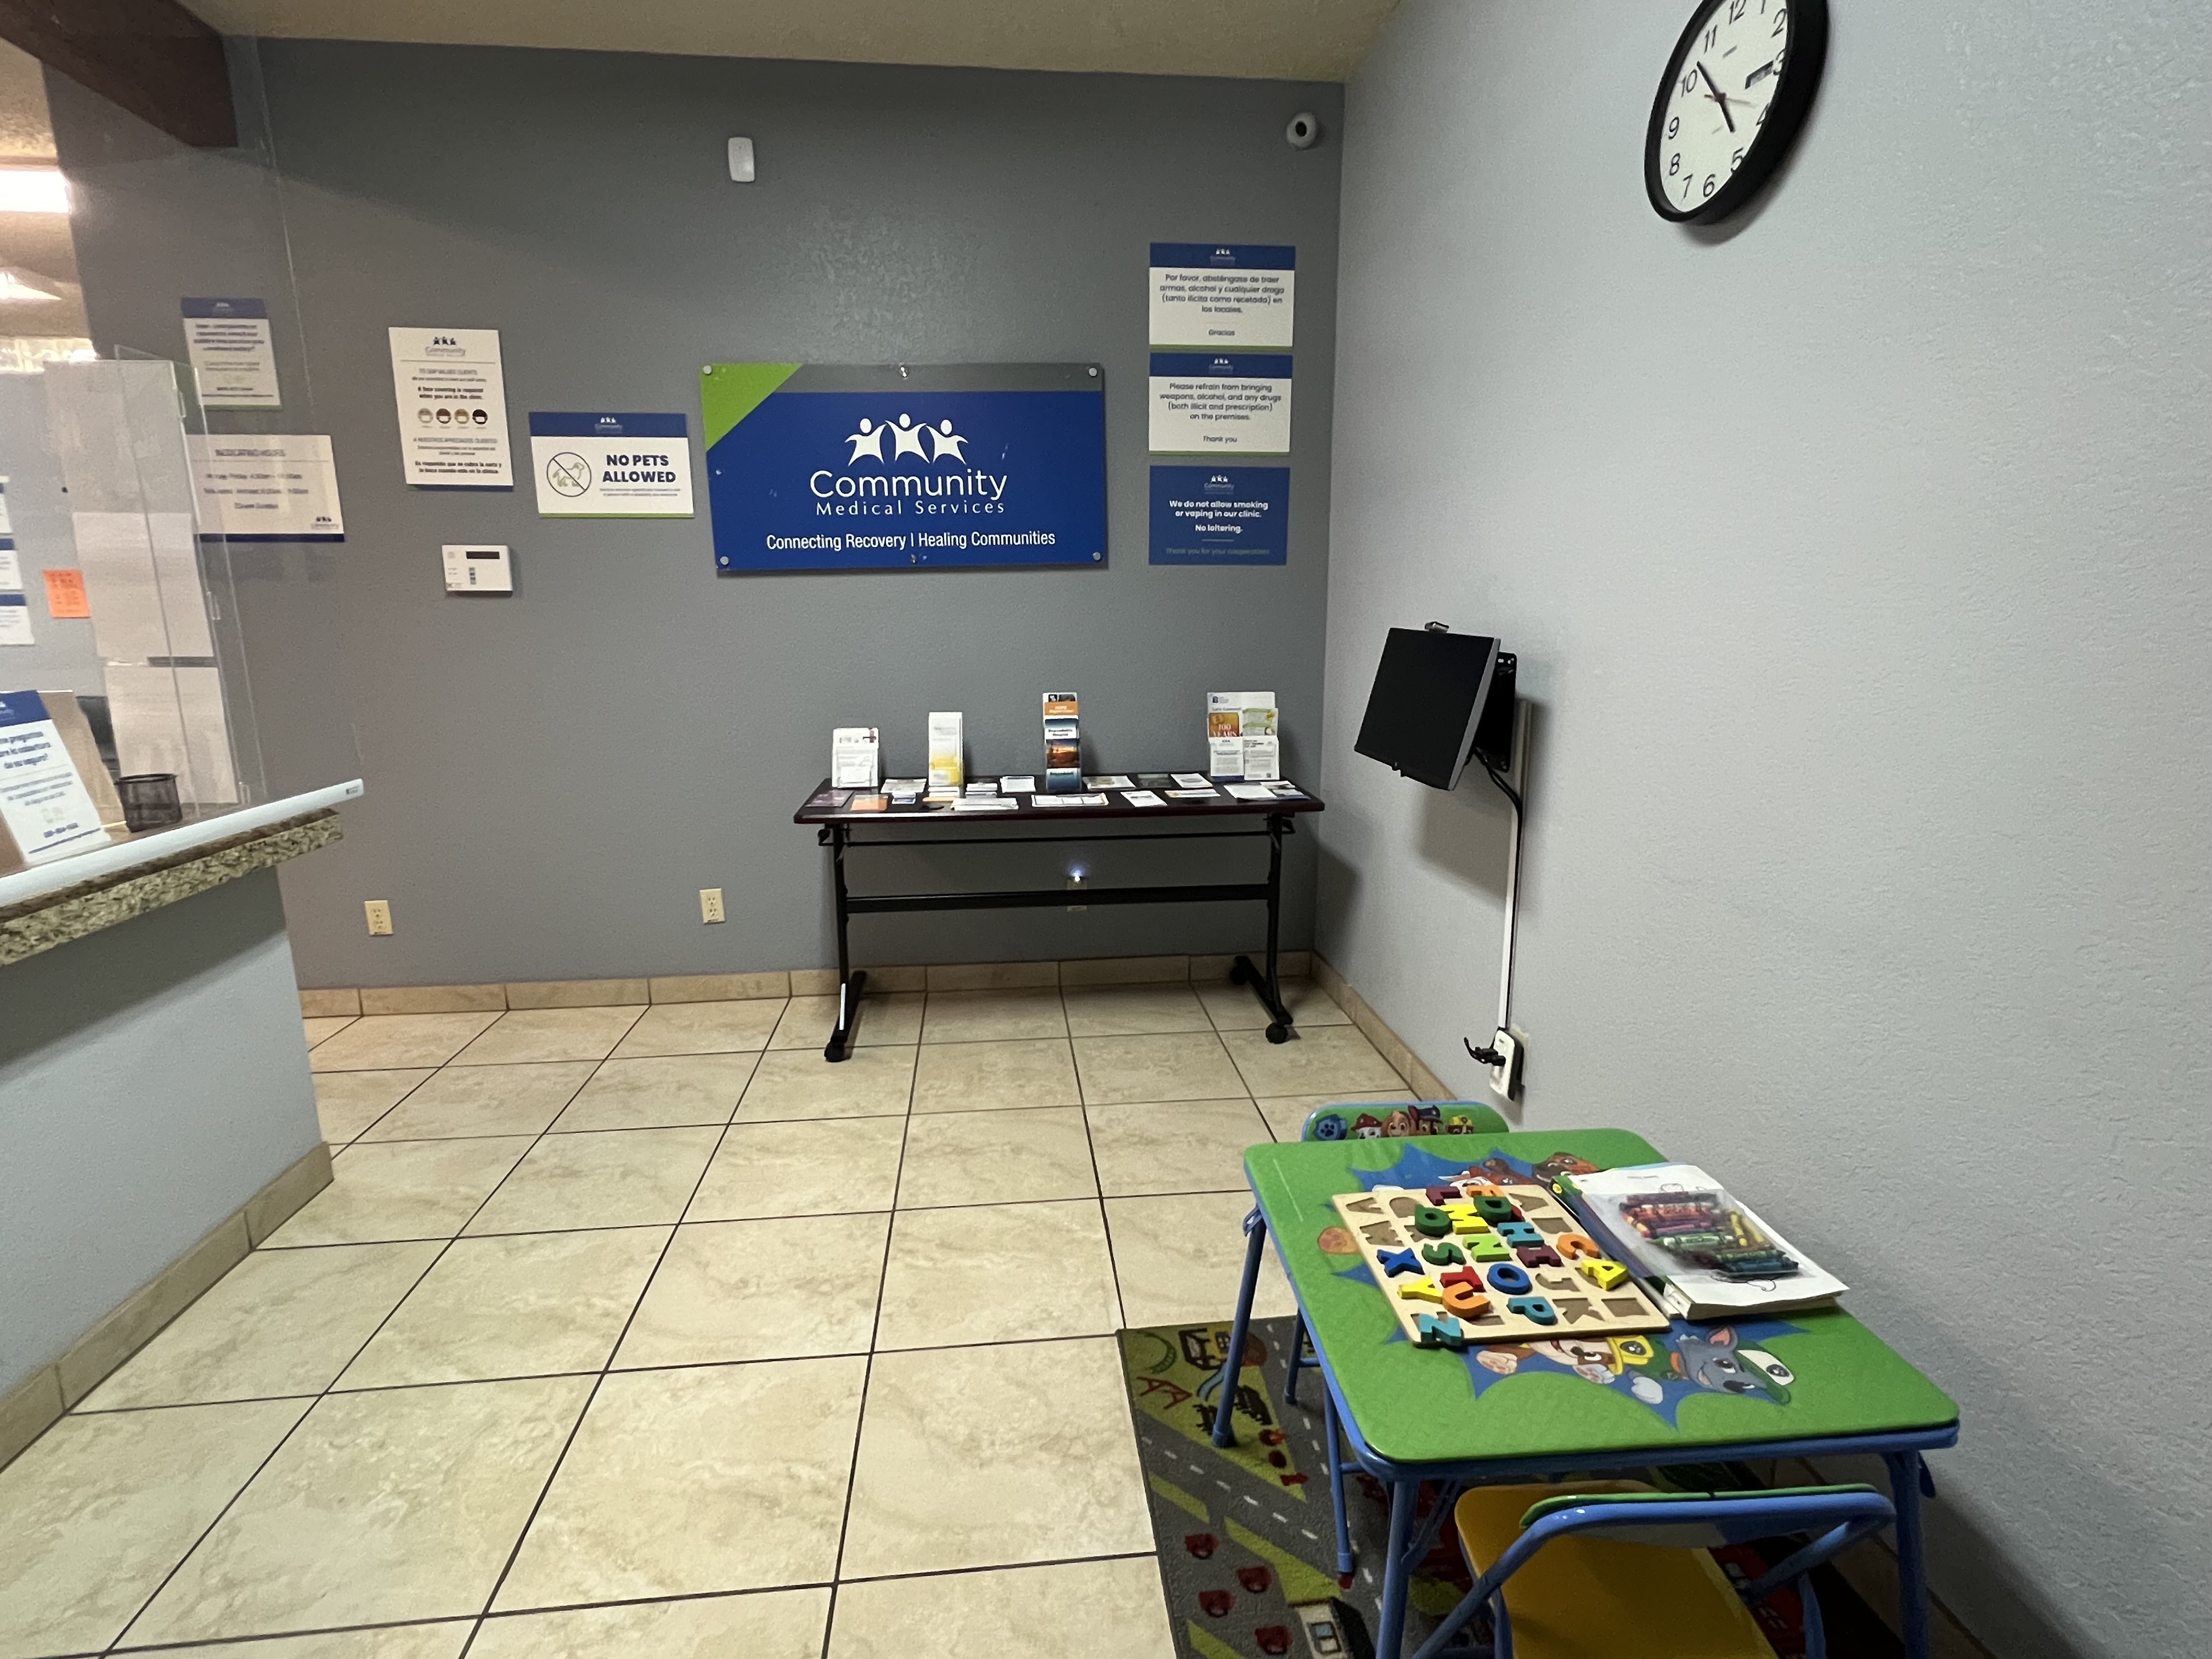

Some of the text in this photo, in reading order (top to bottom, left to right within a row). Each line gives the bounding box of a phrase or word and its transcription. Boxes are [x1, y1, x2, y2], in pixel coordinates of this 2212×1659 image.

[1771, 8, 1787, 38] 2
[1704, 25, 1718, 54] 11
[1681, 70, 1697, 98] 10
[1669, 116, 1680, 139] 9
[1669, 153, 1680, 176] 8
[1683, 174, 1693, 199] 7
[1703, 174, 1716, 198] 6
[1224, 286, 1260, 294] cualquier
[1234, 296, 1271, 305] recetada)
[1241, 384, 1272, 393] bringing
[607, 455, 669, 466] NO PETS
[602, 471, 676, 483] ALLOWED
[810, 469, 1008, 500] Community
[816, 500, 1005, 515] Medical Services
[1185, 510, 1213, 519] vaping
[1234, 501, 1268, 510] smoking
[1207, 524, 1243, 534] loitering.
[767, 534, 842, 551] Connecting
[846, 533, 906, 550] Recovery
[919, 532, 967, 549] Healing
[972, 531, 1054, 546] Communities
[1487, 1263, 1532, 1295] O
[1581, 1259, 1628, 1291] A
